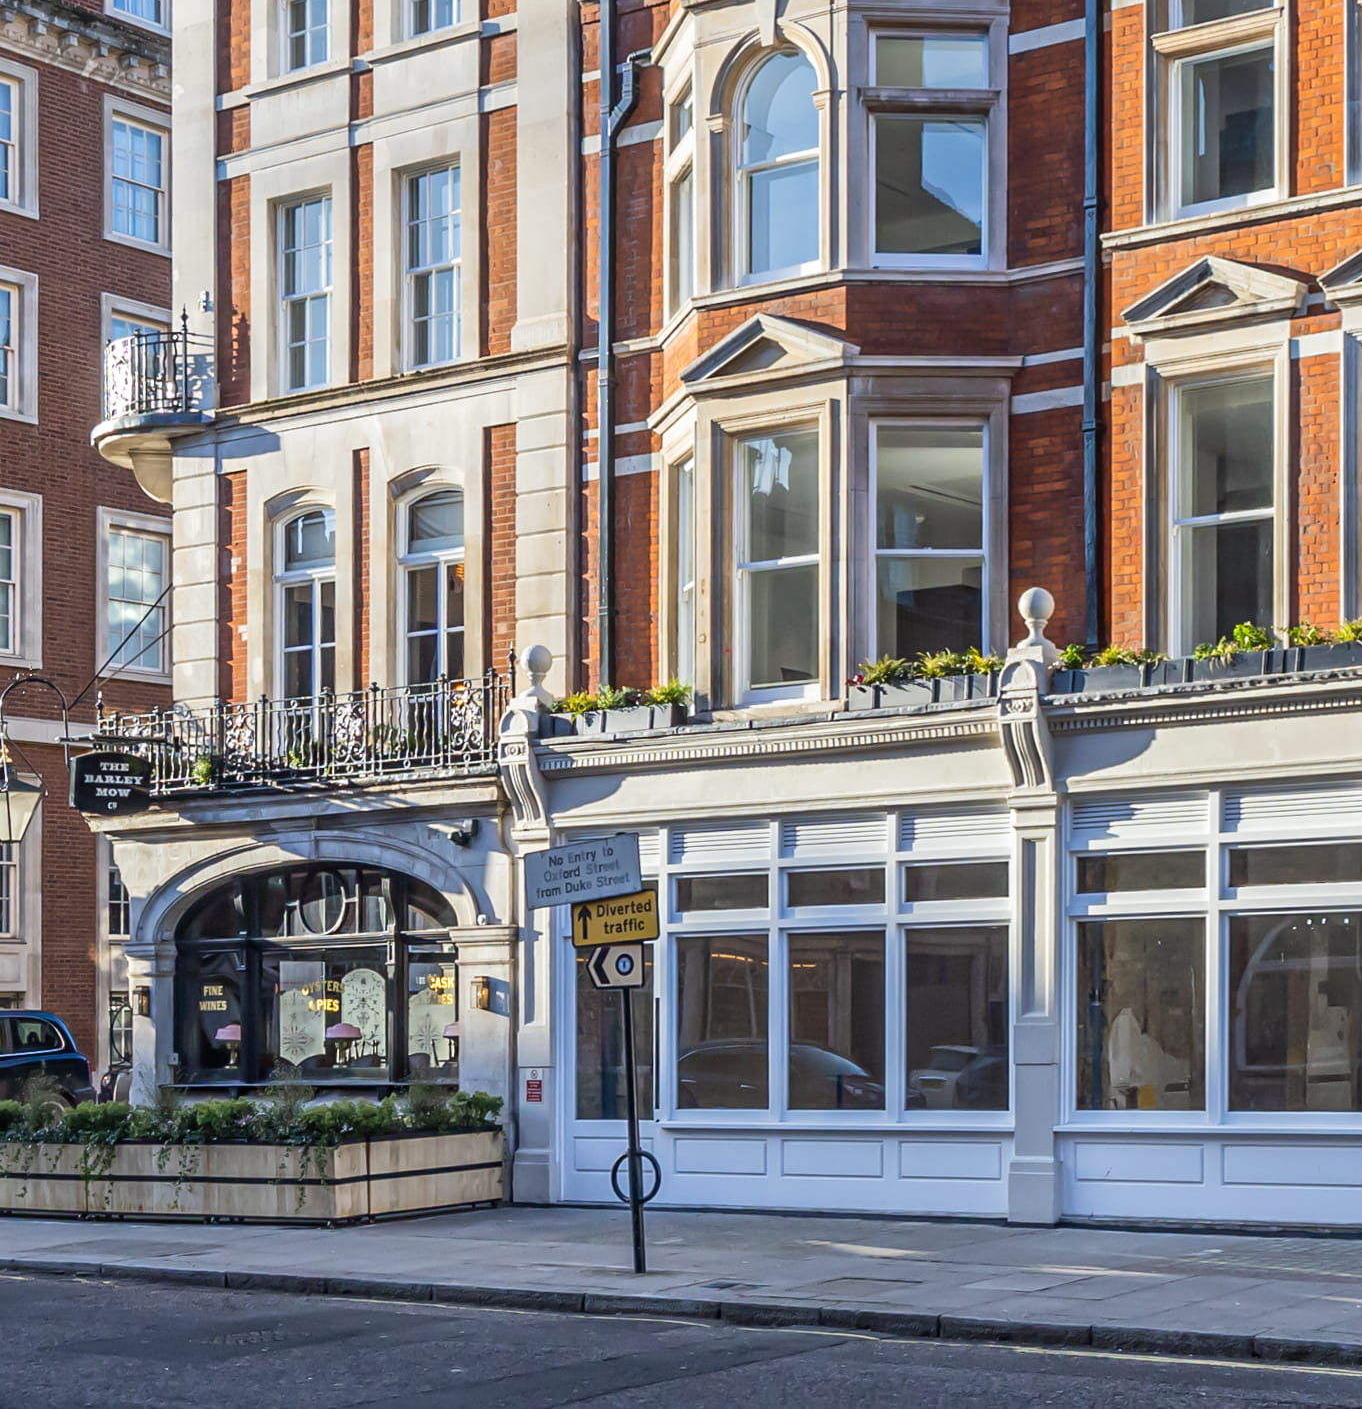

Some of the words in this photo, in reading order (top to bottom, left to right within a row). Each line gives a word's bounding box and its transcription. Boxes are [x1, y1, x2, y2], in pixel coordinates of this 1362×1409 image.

[100, 762, 129, 771] THE
[84, 774, 143, 784] BARLEY
[96, 788, 131, 797] MOW
[549, 855, 563, 867] No
[568, 850, 596, 863] Entry
[602, 845, 614, 857] to
[544, 865, 580, 882] Oxford
[586, 858, 620, 874] Street
[536, 887, 561, 899] from
[565, 880, 592, 893] Duke
[596, 872, 630, 887] Street
[596, 899, 652, 918] Diverted
[604, 918, 645, 934] traffic
[203, 985, 223, 996] FINE
[199, 1000, 227, 1011] WINES
[316, 998, 340, 1012] PIES
